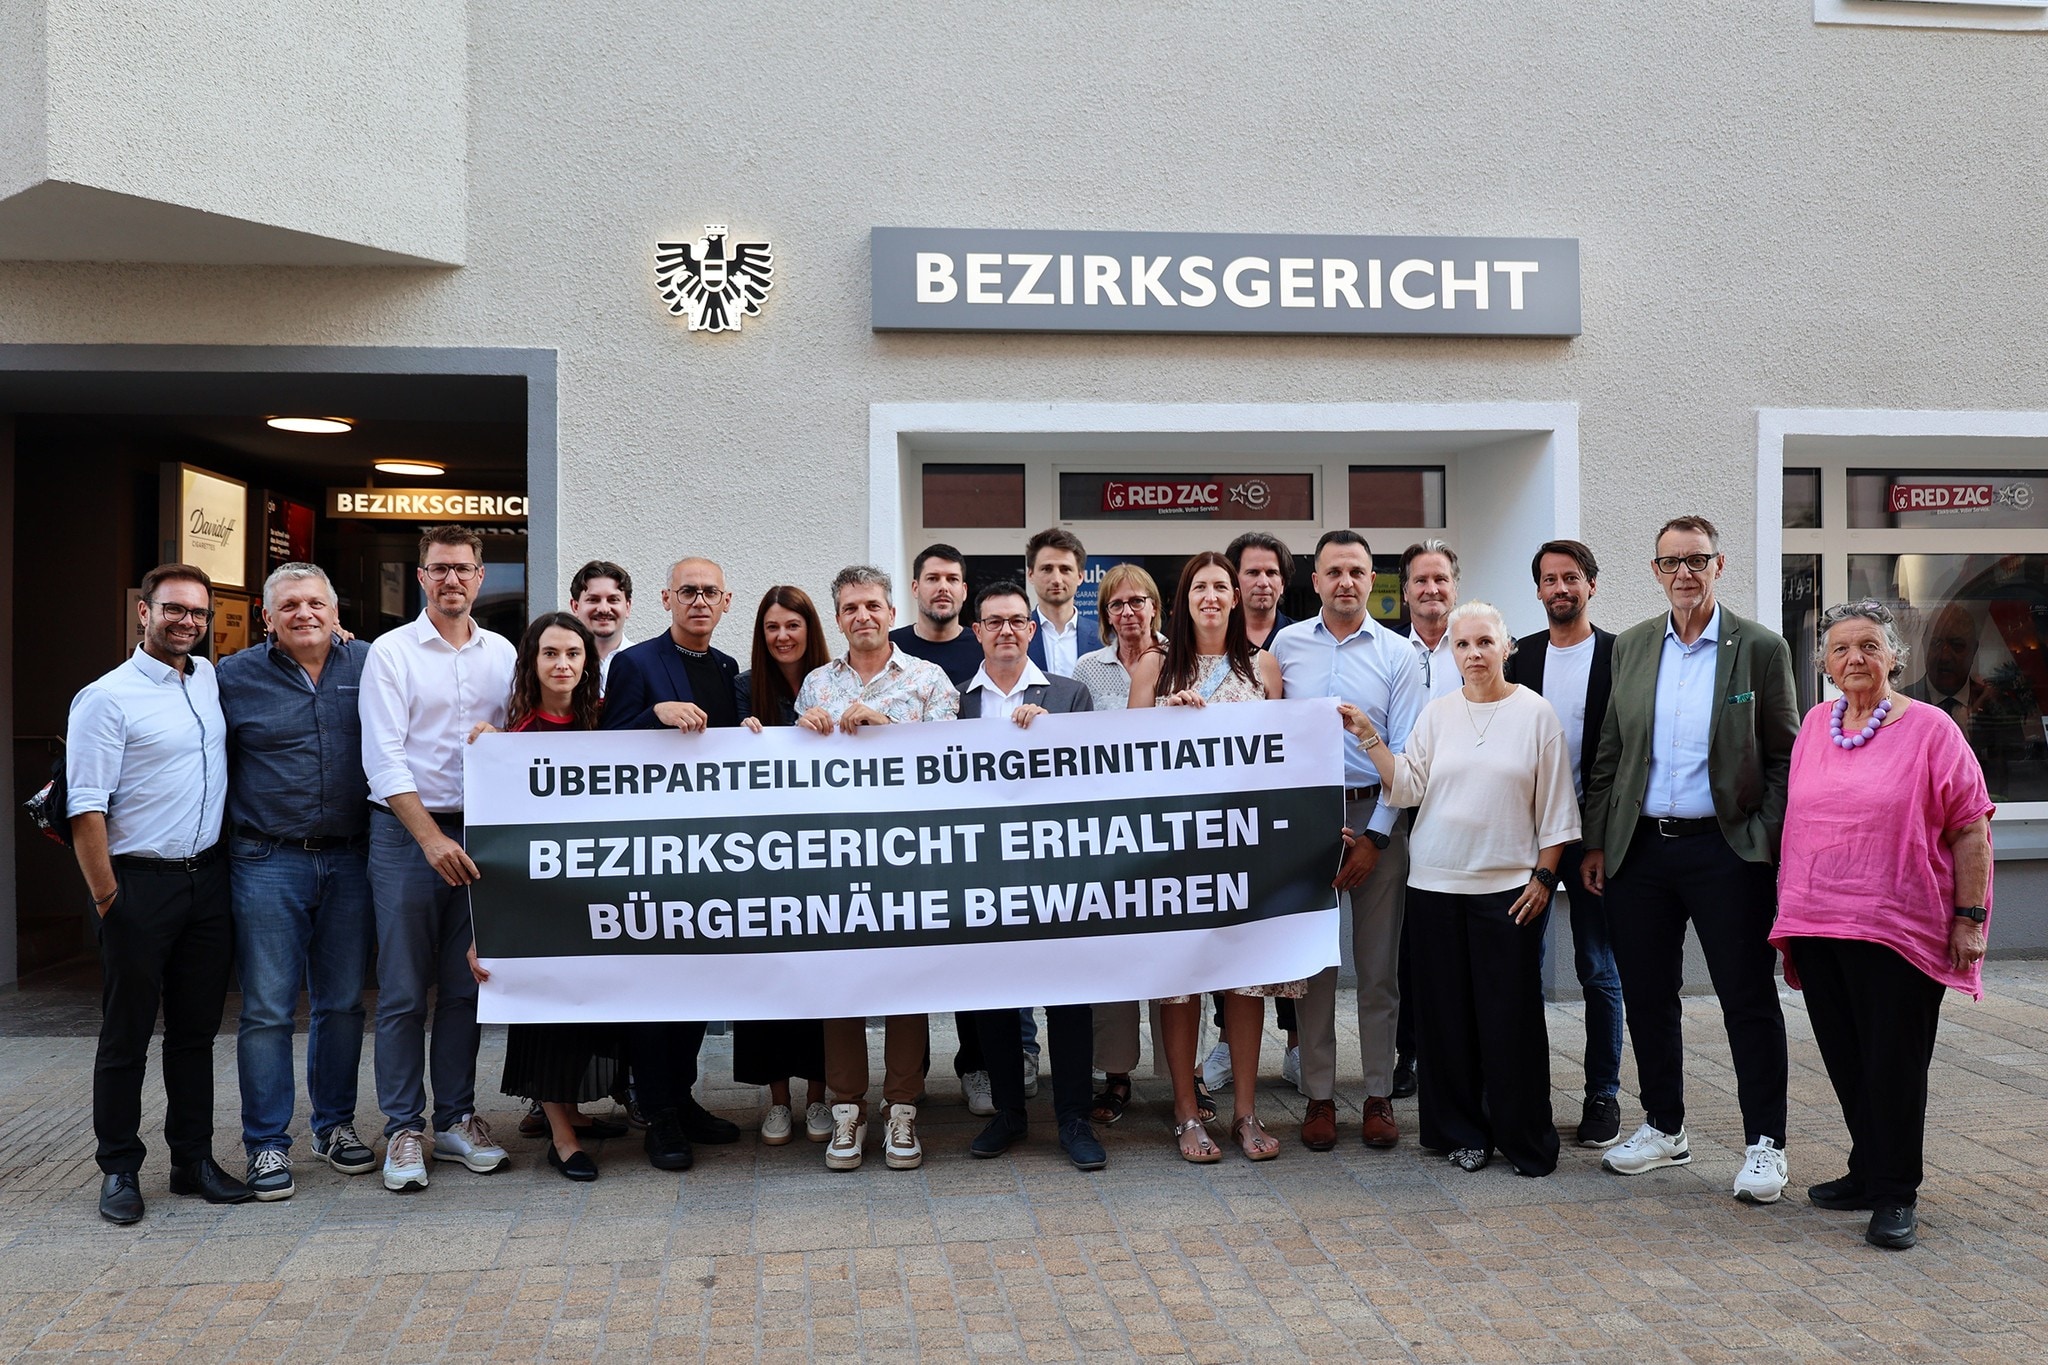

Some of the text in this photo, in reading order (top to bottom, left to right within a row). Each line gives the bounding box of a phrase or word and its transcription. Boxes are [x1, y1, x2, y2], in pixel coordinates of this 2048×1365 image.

[916, 252, 1539, 310] BEZIRKSGERICHT
[1128, 485, 1219, 505] RED ZAC
[1910, 488, 1950, 507] RED
[1953, 486, 1990, 506] ZAC
[190, 507, 236, 547] Davidoff
[529, 733, 1285, 798] ÜBERPARTEILICHE BÜRGERINITIATIVE
[529, 823, 985, 880] BEZIRKSGERICHT
[1000, 807, 1259, 861] ERHALTEN
[587, 871, 1249, 940] BÜRGERNÄHE BEWAHREN
